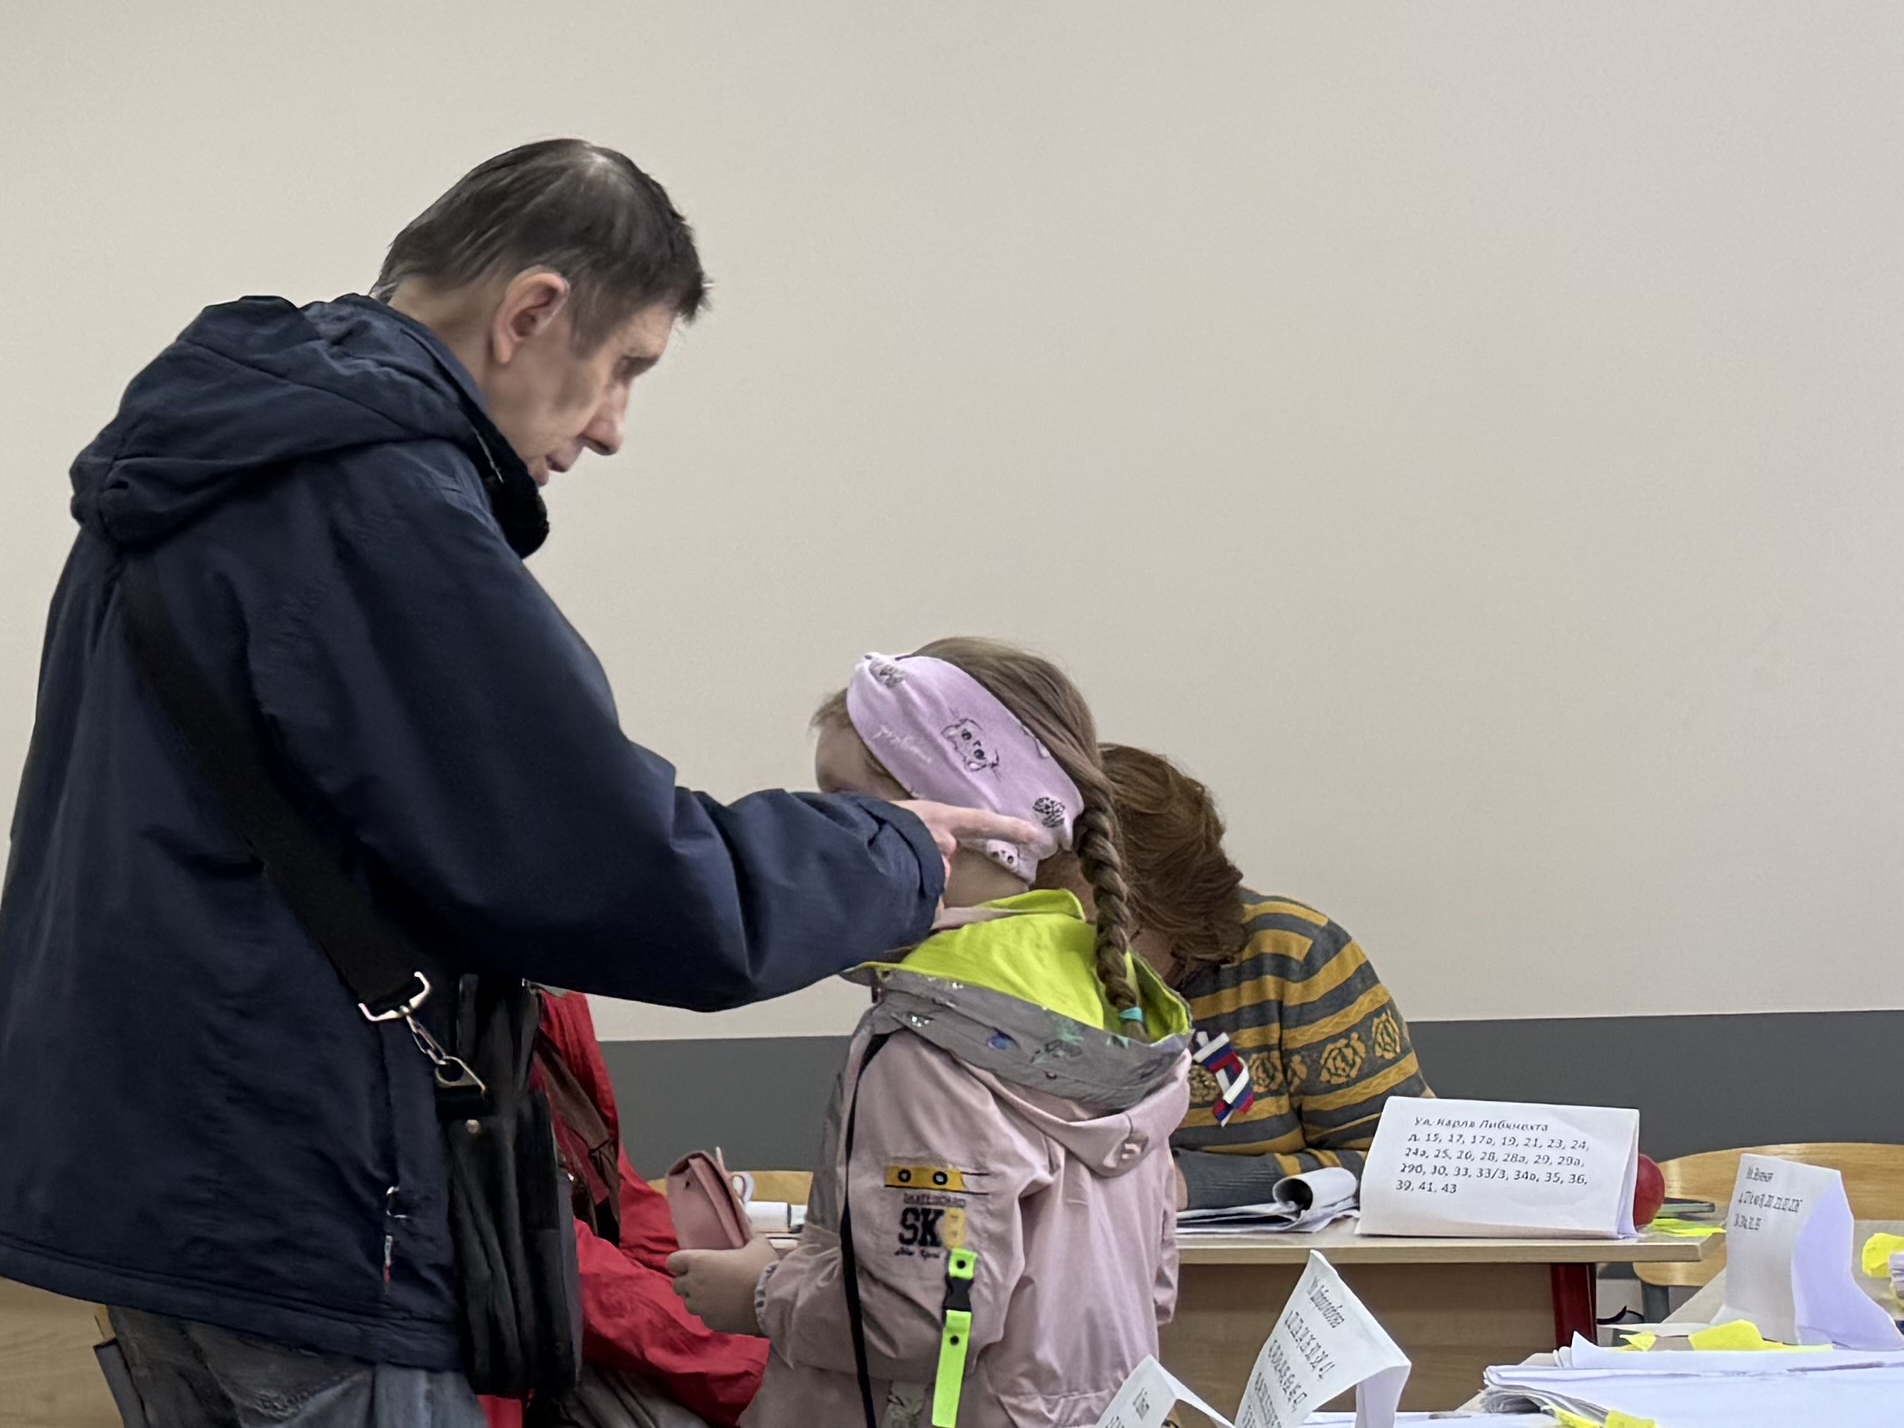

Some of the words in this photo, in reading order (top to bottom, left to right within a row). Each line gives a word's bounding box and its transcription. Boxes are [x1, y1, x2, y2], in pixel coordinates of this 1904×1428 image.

[1436, 1118, 1475, 1129] Карла
[1479, 1119, 1548, 1132] Либкнехта
[1476, 1167, 1509, 1181] 33/3,
[1544, 1172, 1564, 1184] 35,
[1568, 1173, 1587, 1185] 36,
[1441, 1183, 1457, 1194] 43
